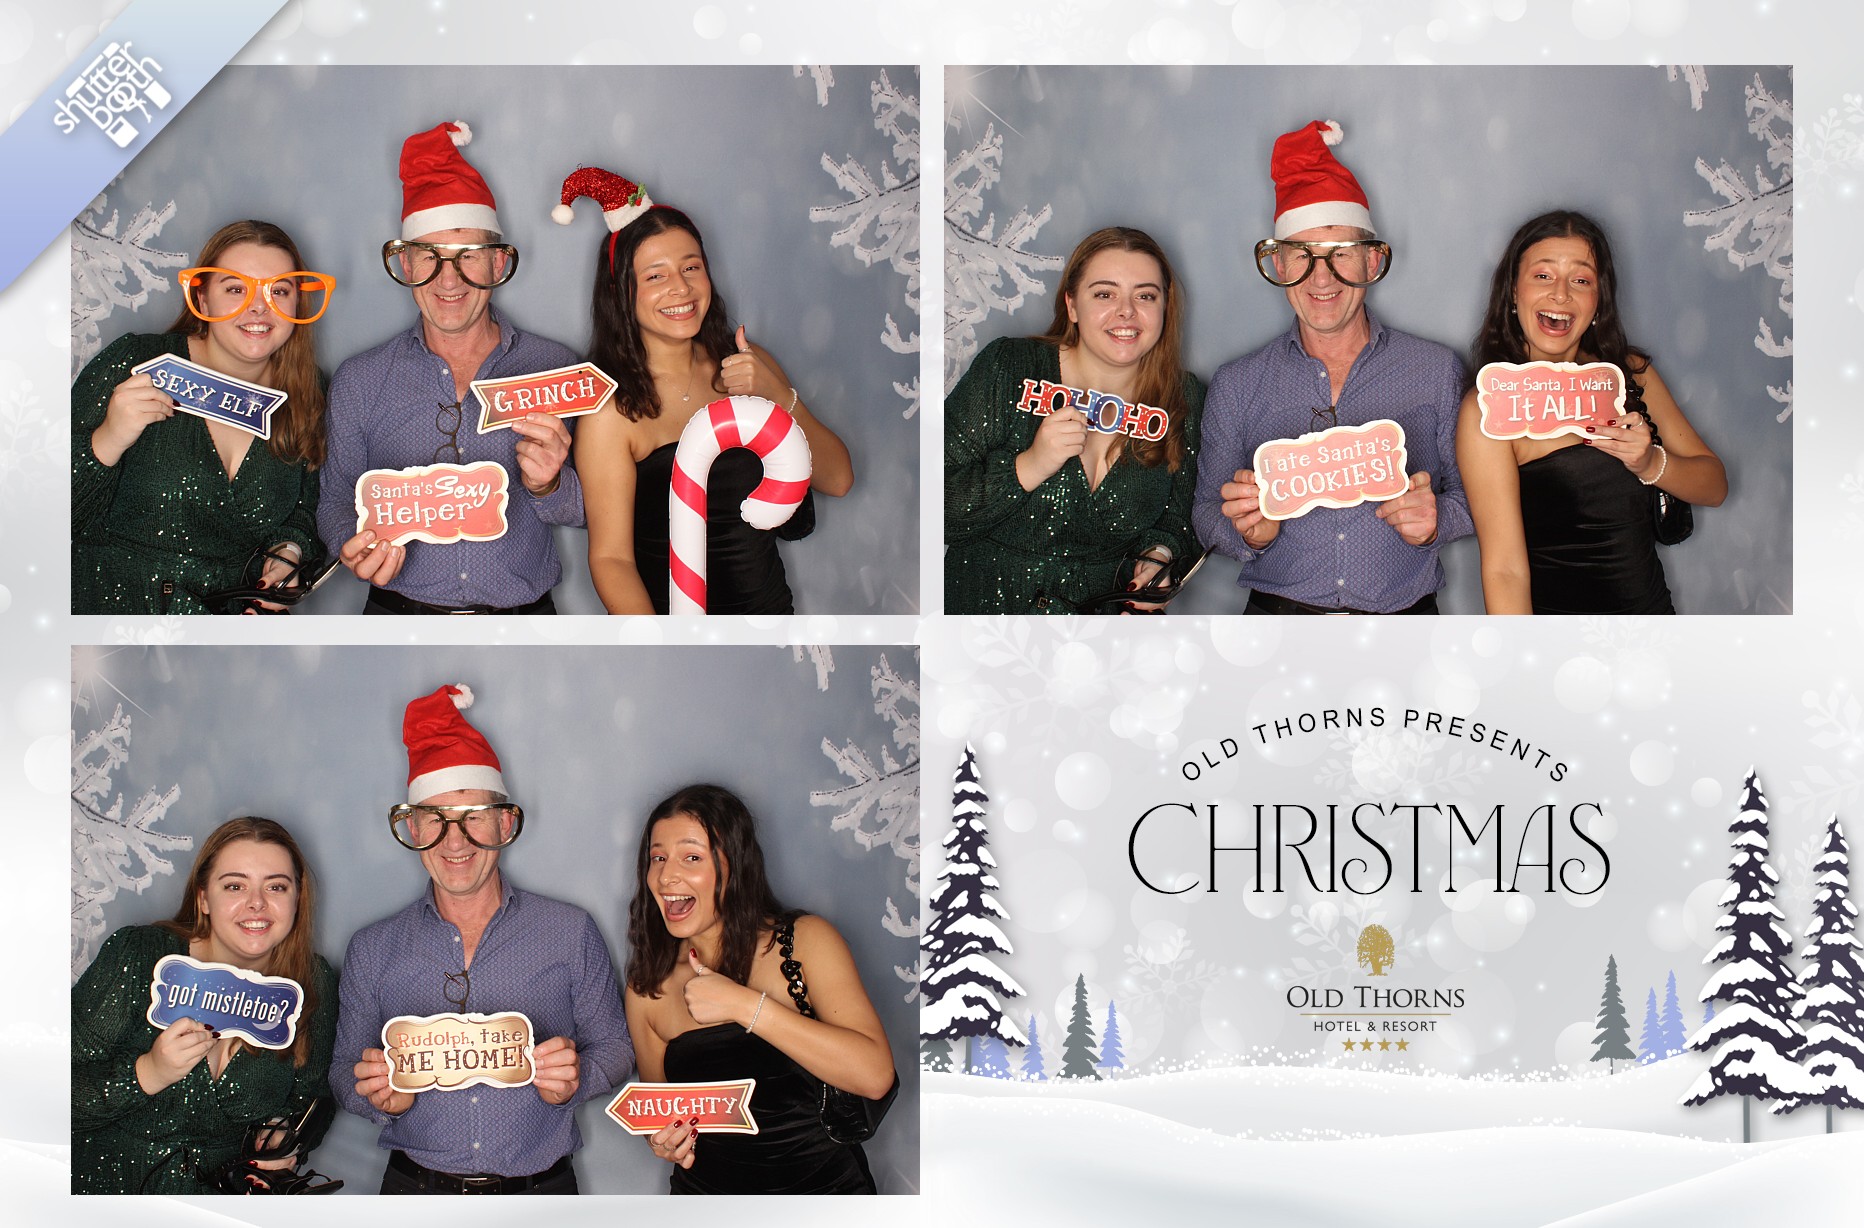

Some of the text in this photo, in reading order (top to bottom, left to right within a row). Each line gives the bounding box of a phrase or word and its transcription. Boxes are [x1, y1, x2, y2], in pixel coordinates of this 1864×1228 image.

[151, 369, 263, 418] SEXY ELF
[493, 376, 596, 413] GRINCH
[1491, 377, 1613, 392] Dear Santa, I Want
[1508, 394, 1597, 422] It ALL!
[1264, 437, 1391, 474] I ate Santa's
[371, 475, 491, 507] Santa's Sexy
[1271, 455, 1395, 501] COOKIES!
[374, 500, 474, 528] Helper
[168, 983, 289, 1024] got mistletoe?
[396, 1029, 523, 1048] Rudolph, take
[397, 1044, 524, 1073] ME HOME!
[628, 1097, 738, 1116] NAUGHTY
